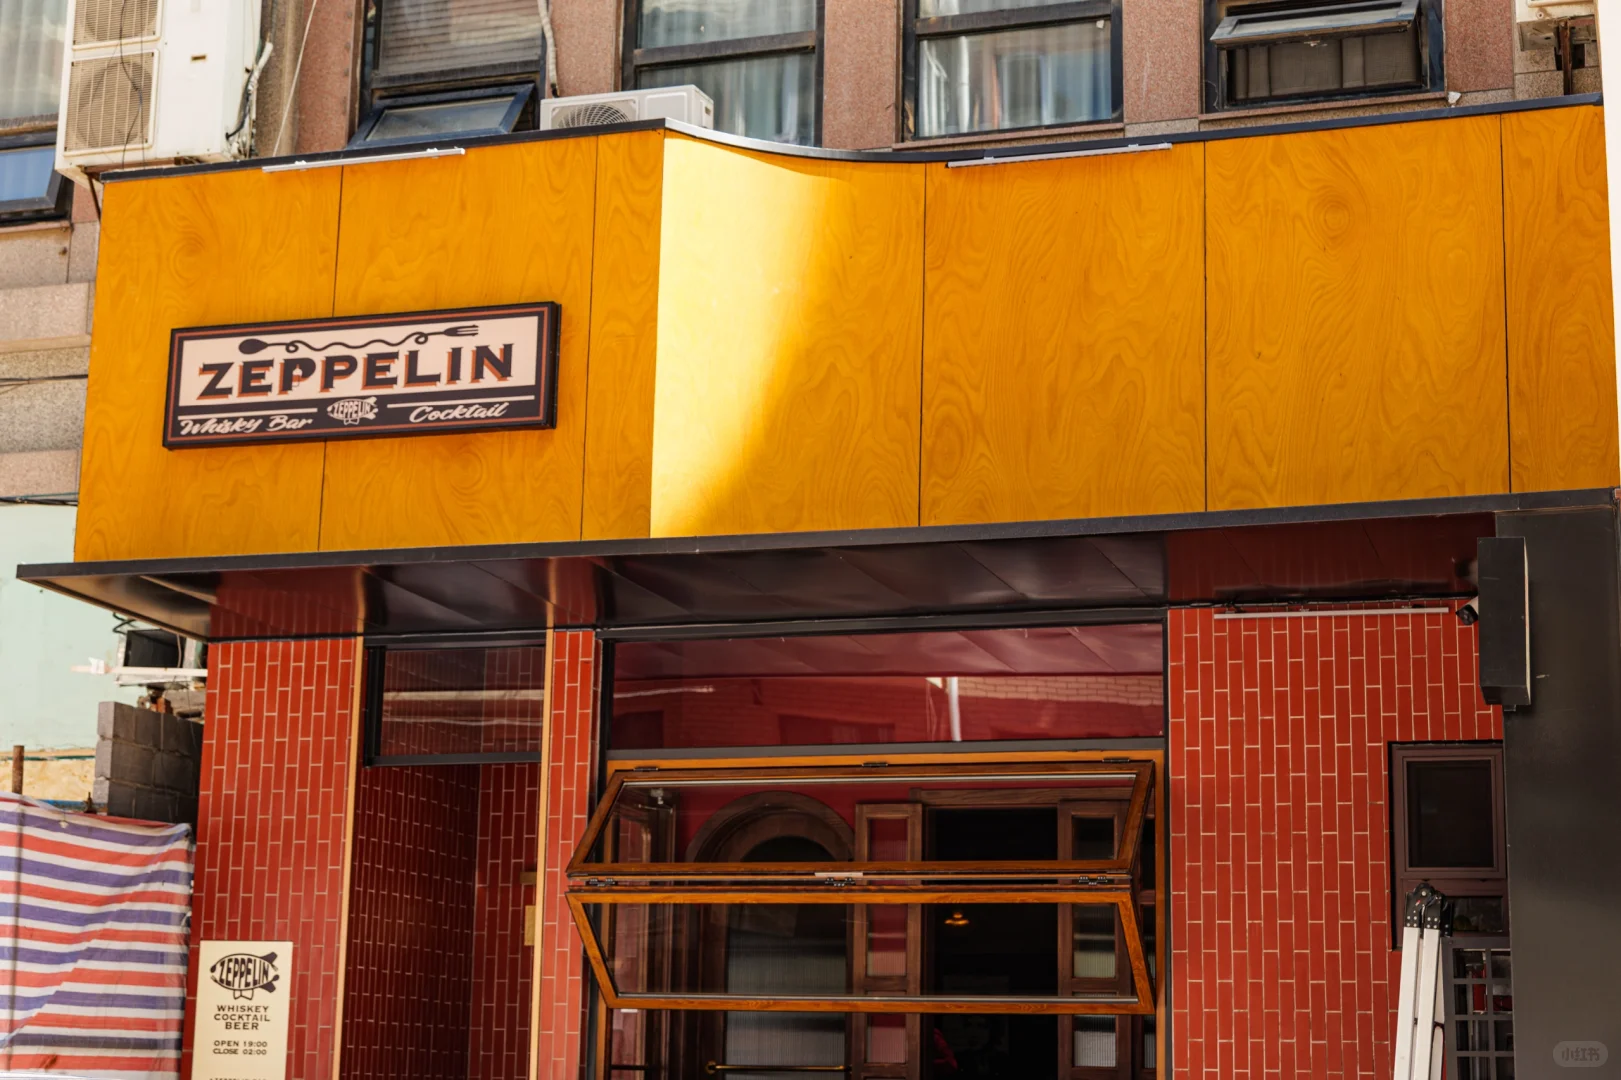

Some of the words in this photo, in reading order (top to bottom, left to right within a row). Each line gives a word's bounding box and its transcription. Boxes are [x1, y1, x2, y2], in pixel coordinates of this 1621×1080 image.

[196, 343, 515, 400] ZEPPELIN
[332, 400, 371, 419] ZEPPELIN
[409, 402, 510, 424] Cocktail
[180, 418, 264, 435] Whisky
[266, 415, 313, 431] Bar
[219, 957, 270, 988] ZEPPELIN
[213, 1013, 271, 1022] COCKTAIL
[216, 1004, 270, 1013] WHISKEY
[225, 1022, 259, 1030] BEER
[242, 1048, 267, 1056] 02:00
